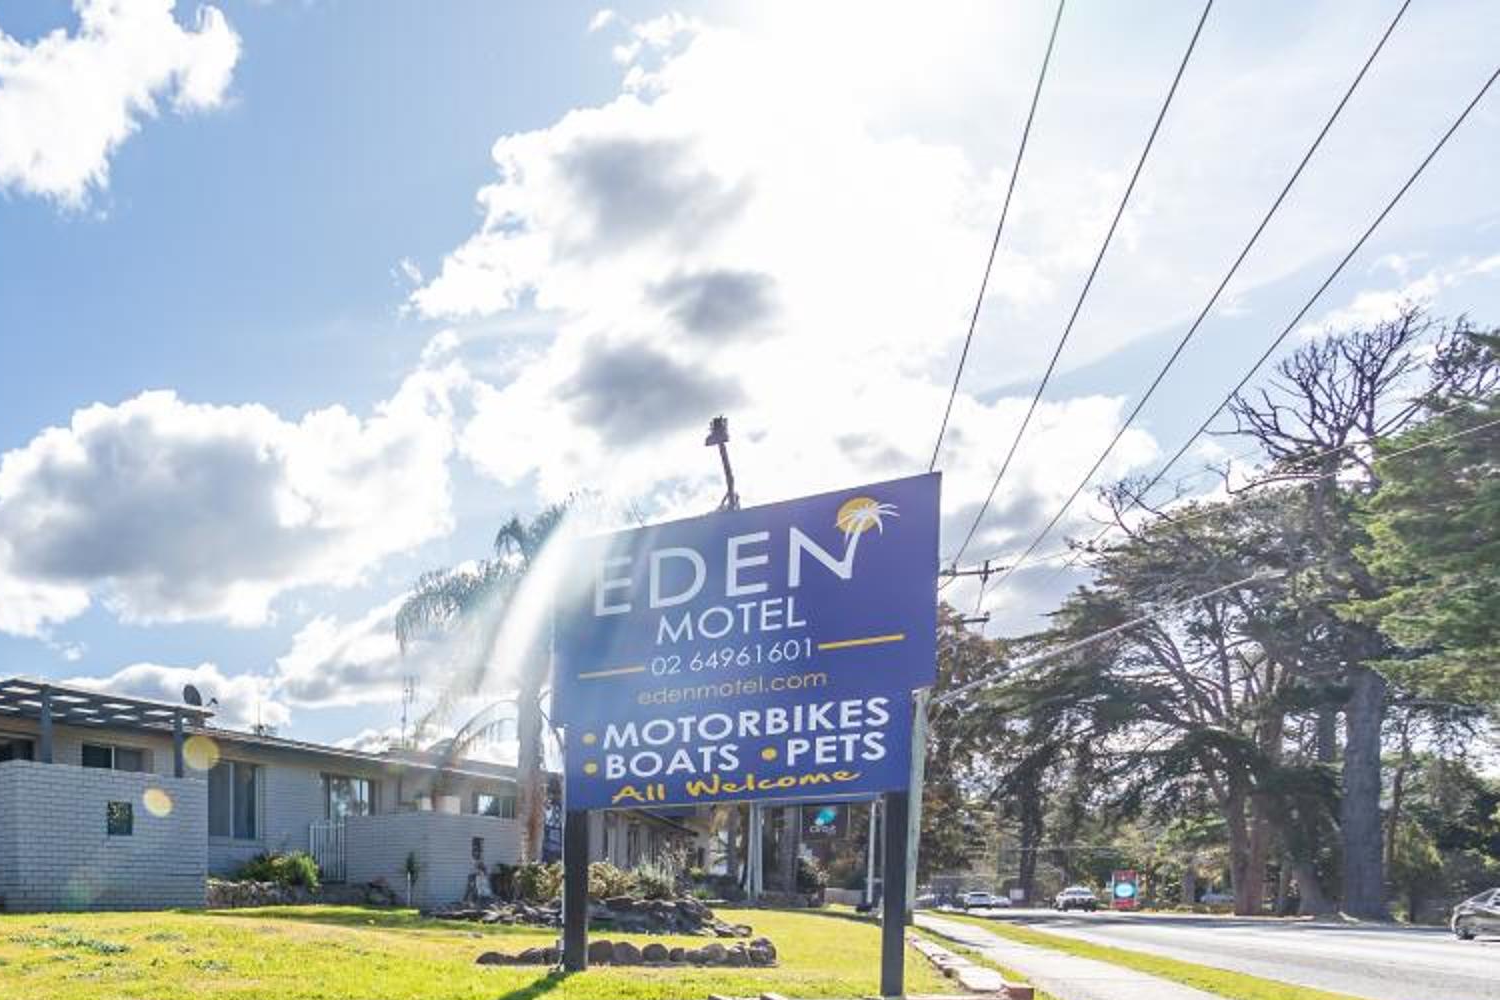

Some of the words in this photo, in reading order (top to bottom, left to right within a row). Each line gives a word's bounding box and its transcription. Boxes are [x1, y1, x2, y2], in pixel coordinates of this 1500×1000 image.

[595, 522, 862, 617] EDEN
[655, 597, 807, 646] MOTEL
[651, 655, 682, 677] 02
[689, 637, 812, 673] 64961601
[637, 672, 828, 706] edenmotel.com
[603, 697, 890, 751] MOTORBIKES
[605, 743, 740, 780] BOATS
[787, 731, 887, 767] PETS
[612, 783, 667, 805] All
[685, 770, 862, 797] Welcome
